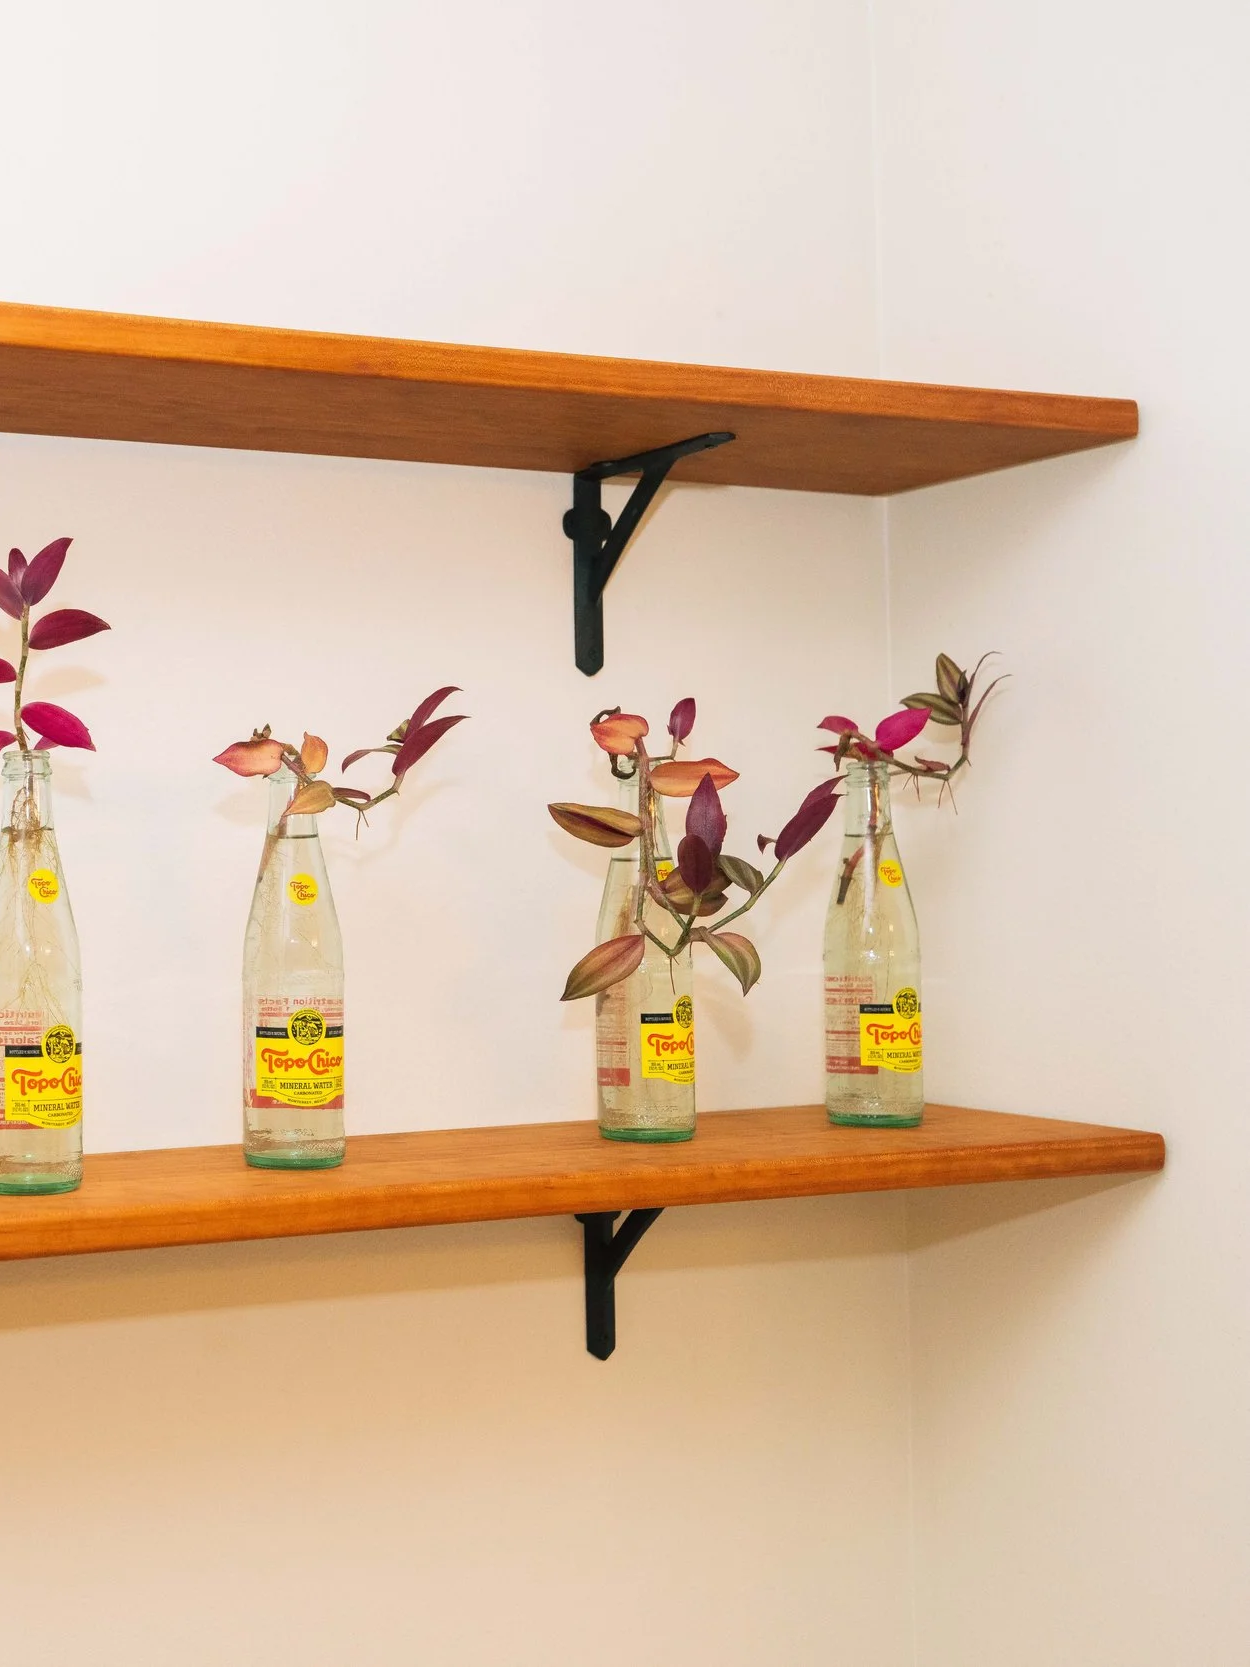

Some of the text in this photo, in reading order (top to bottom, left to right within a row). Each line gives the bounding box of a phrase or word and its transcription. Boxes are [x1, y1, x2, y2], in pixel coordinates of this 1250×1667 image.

[31, 878, 51, 889] Topo
[290, 881, 310, 891] Topo
[39, 887, 57, 898] Chico
[297, 890, 316, 900] Chico
[866, 1023, 910, 1045] Topo
[647, 1033, 687, 1056] Topo
[261, 1048, 343, 1075] Topo Chico
[11, 1069, 62, 1096] Topo
[280, 1082, 312, 1090] MINERAL
[313, 1081, 334, 1089] WATER
[33, 1103, 65, 1112] MINERAL
